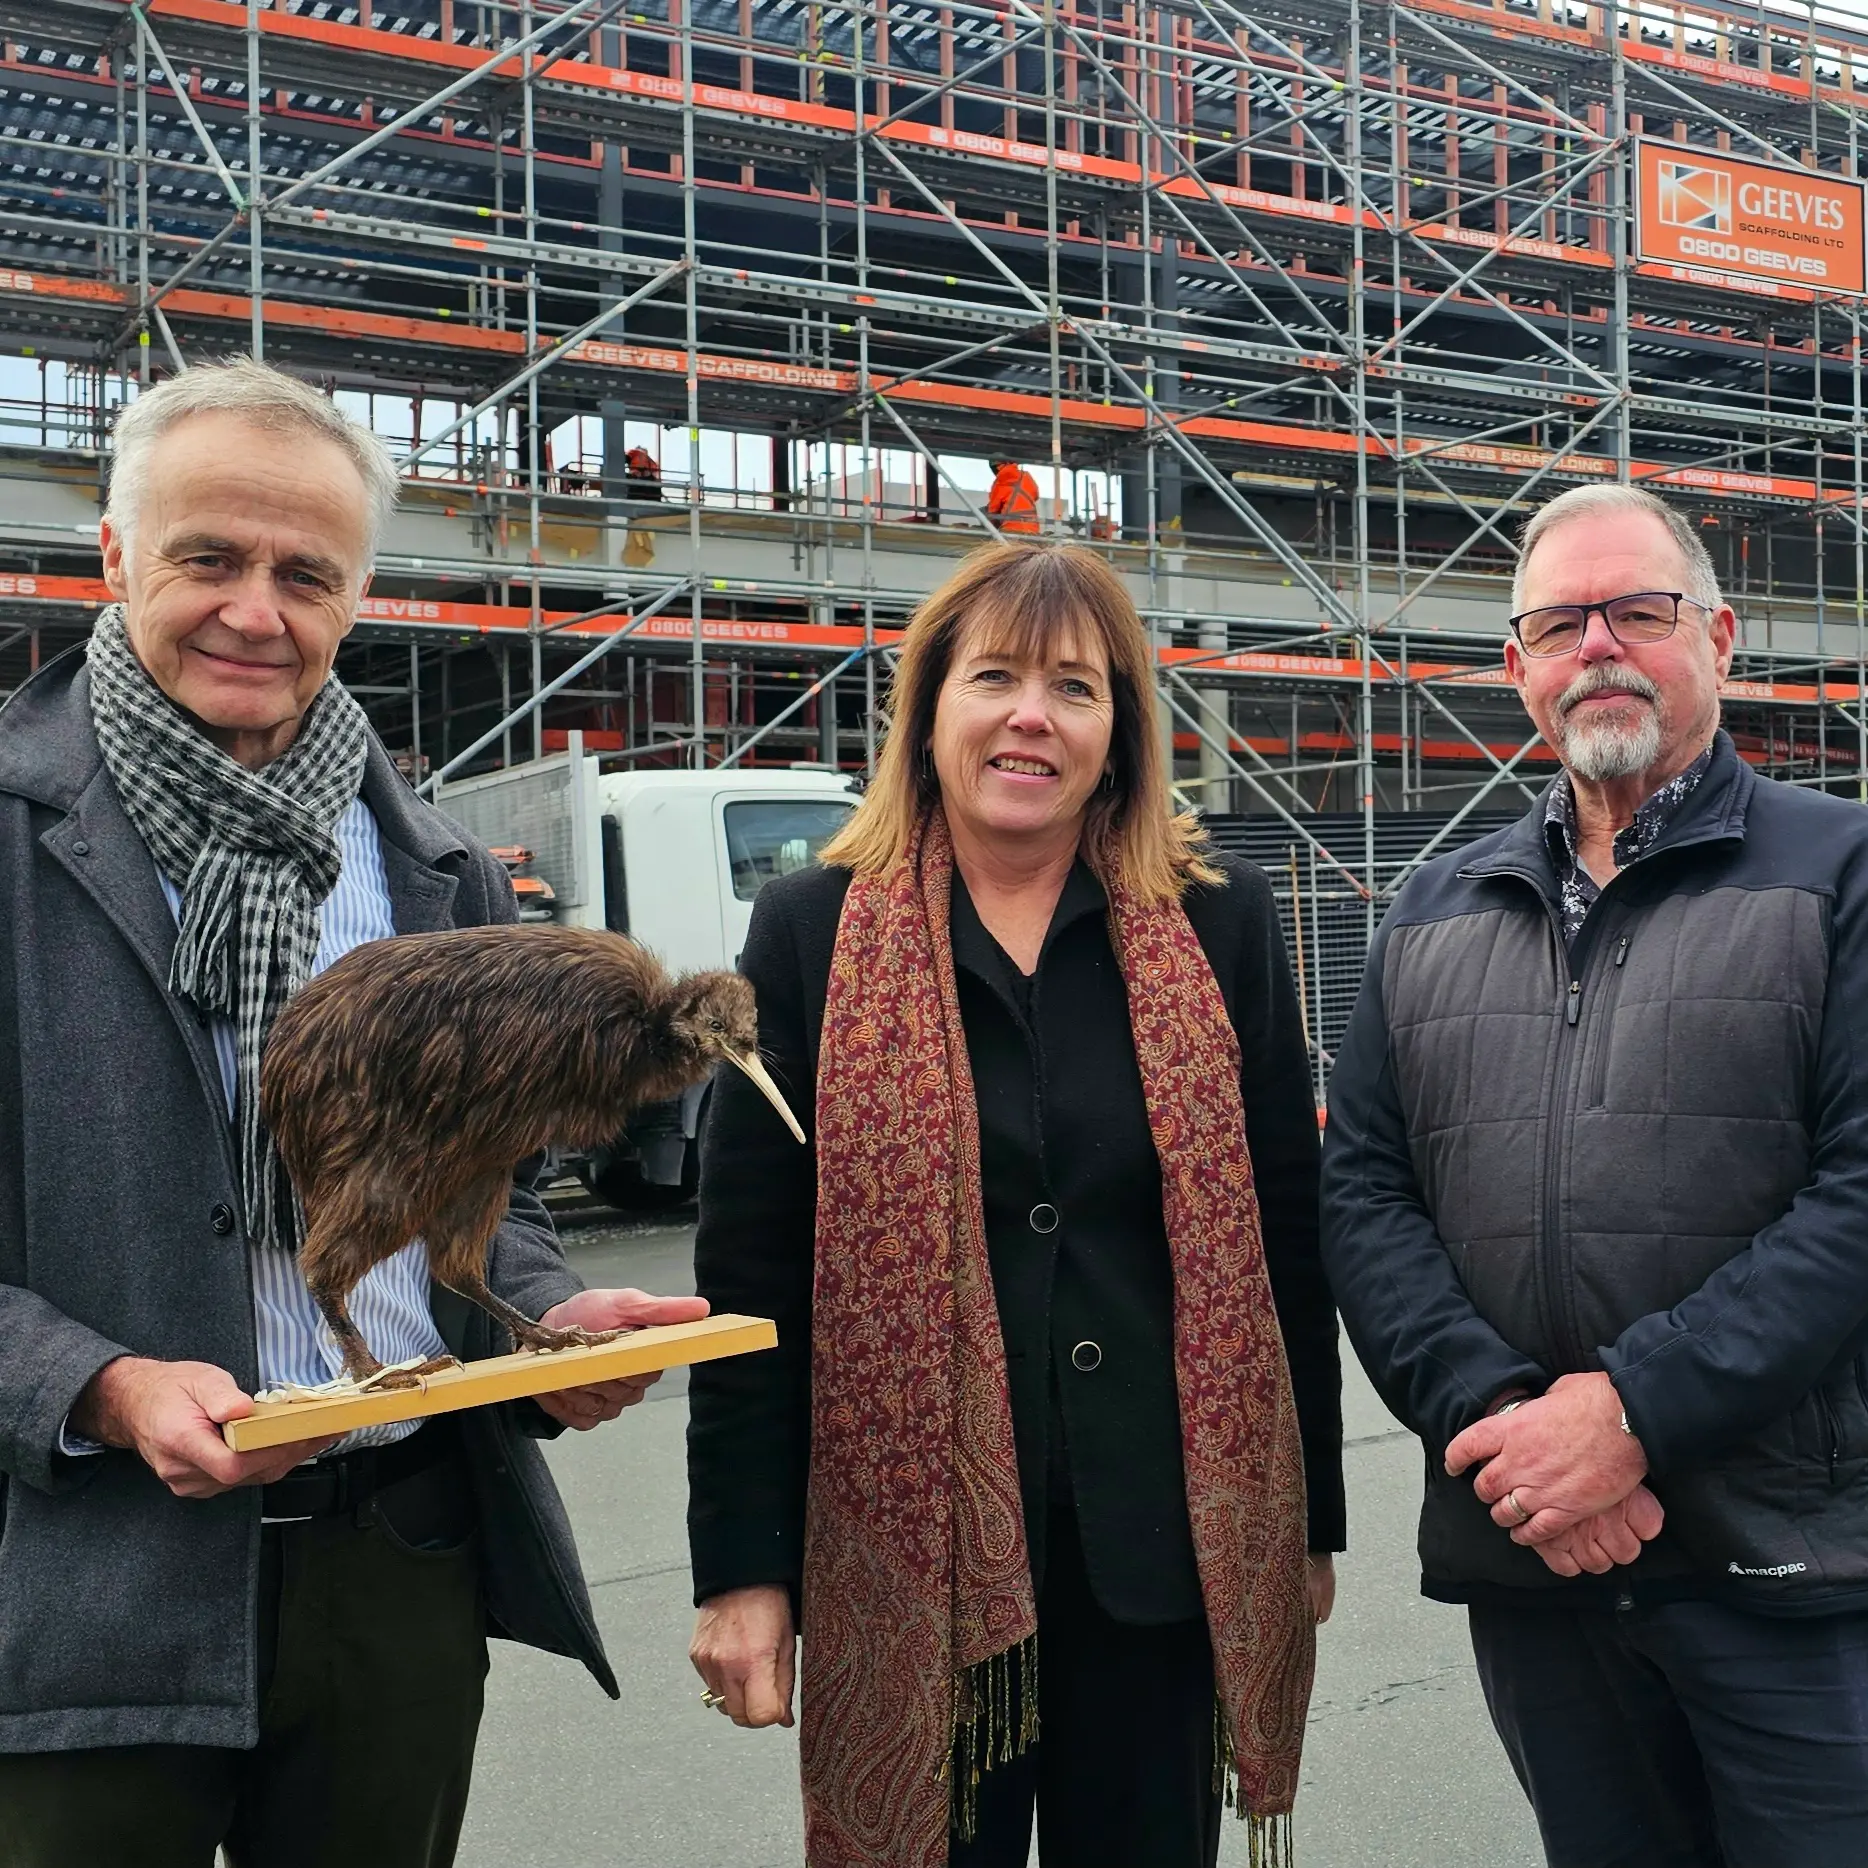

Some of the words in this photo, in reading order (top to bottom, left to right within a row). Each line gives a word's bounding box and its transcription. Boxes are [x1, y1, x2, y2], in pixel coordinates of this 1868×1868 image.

[1717, 64, 1770, 86] GEEVES
[638, 77, 695, 99] 080
[703, 88, 786, 114] GEEVES
[953, 133, 1004, 153] 0800
[1008, 143, 1082, 168] GEEES
[1738, 182, 1845, 231] GEEVES
[1738, 222, 1820, 245] SCAFFOLDING
[1824, 238, 1845, 250] LTD
[1679, 235, 1741, 262] 0800
[1743, 247, 1827, 277] GEEVES
[586, 344, 678, 369] GEEVES
[356, 599, 440, 618] EEVES
[702, 622, 789, 639] GEEVES
[1279, 656, 1344, 673] GEEVES
[1745, 1562, 1807, 1578] macpac
